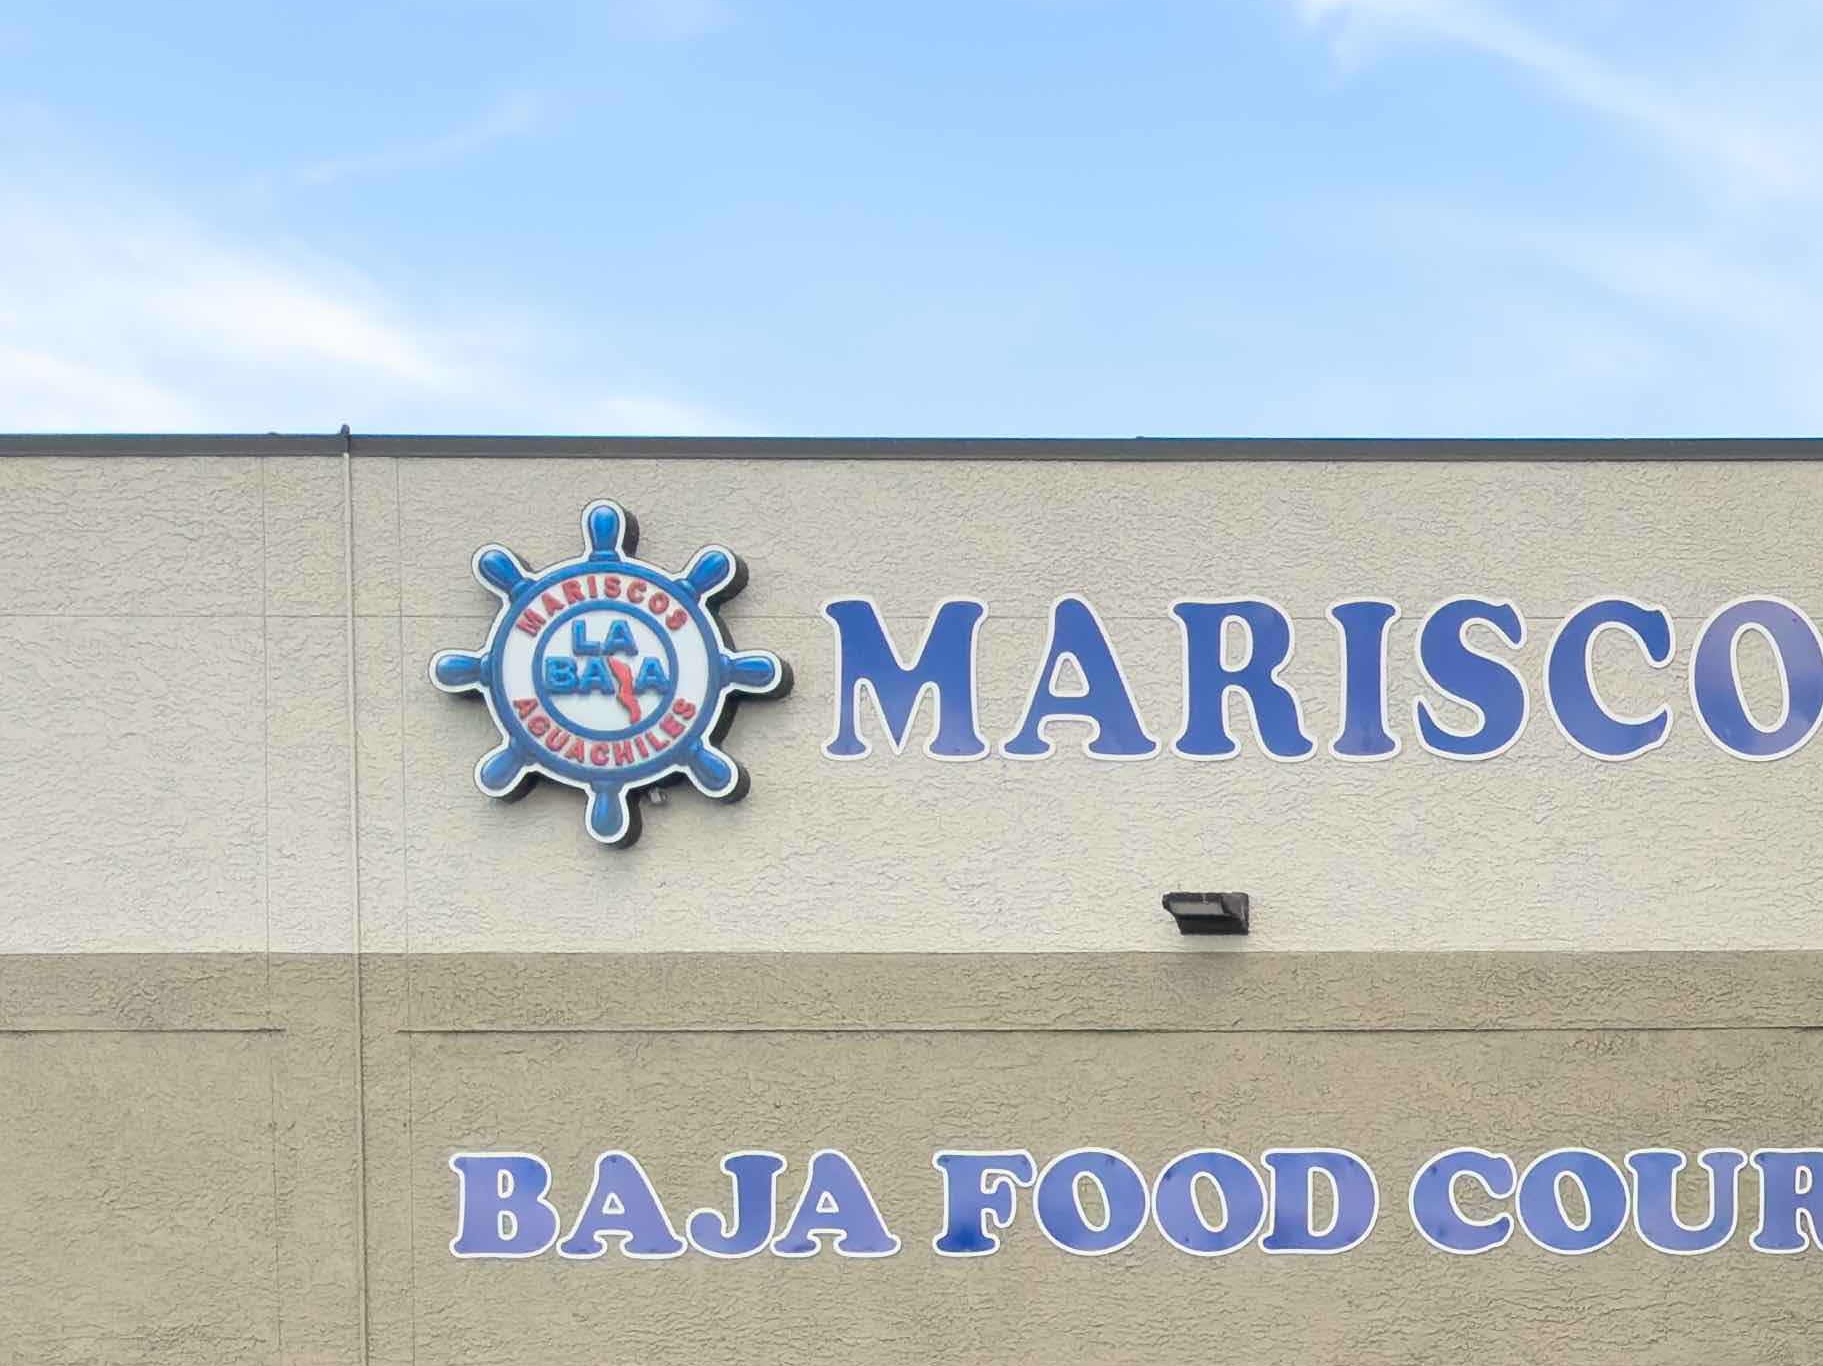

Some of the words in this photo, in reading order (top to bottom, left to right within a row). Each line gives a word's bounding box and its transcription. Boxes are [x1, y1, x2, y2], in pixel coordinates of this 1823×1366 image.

[516, 575, 688, 637] MARISCOS
[571, 619, 638, 656] LA
[513, 696, 697, 766] AGUACHILES
[449, 1150, 901, 1259] BAJA
[932, 1147, 1378, 1258] FOOD
